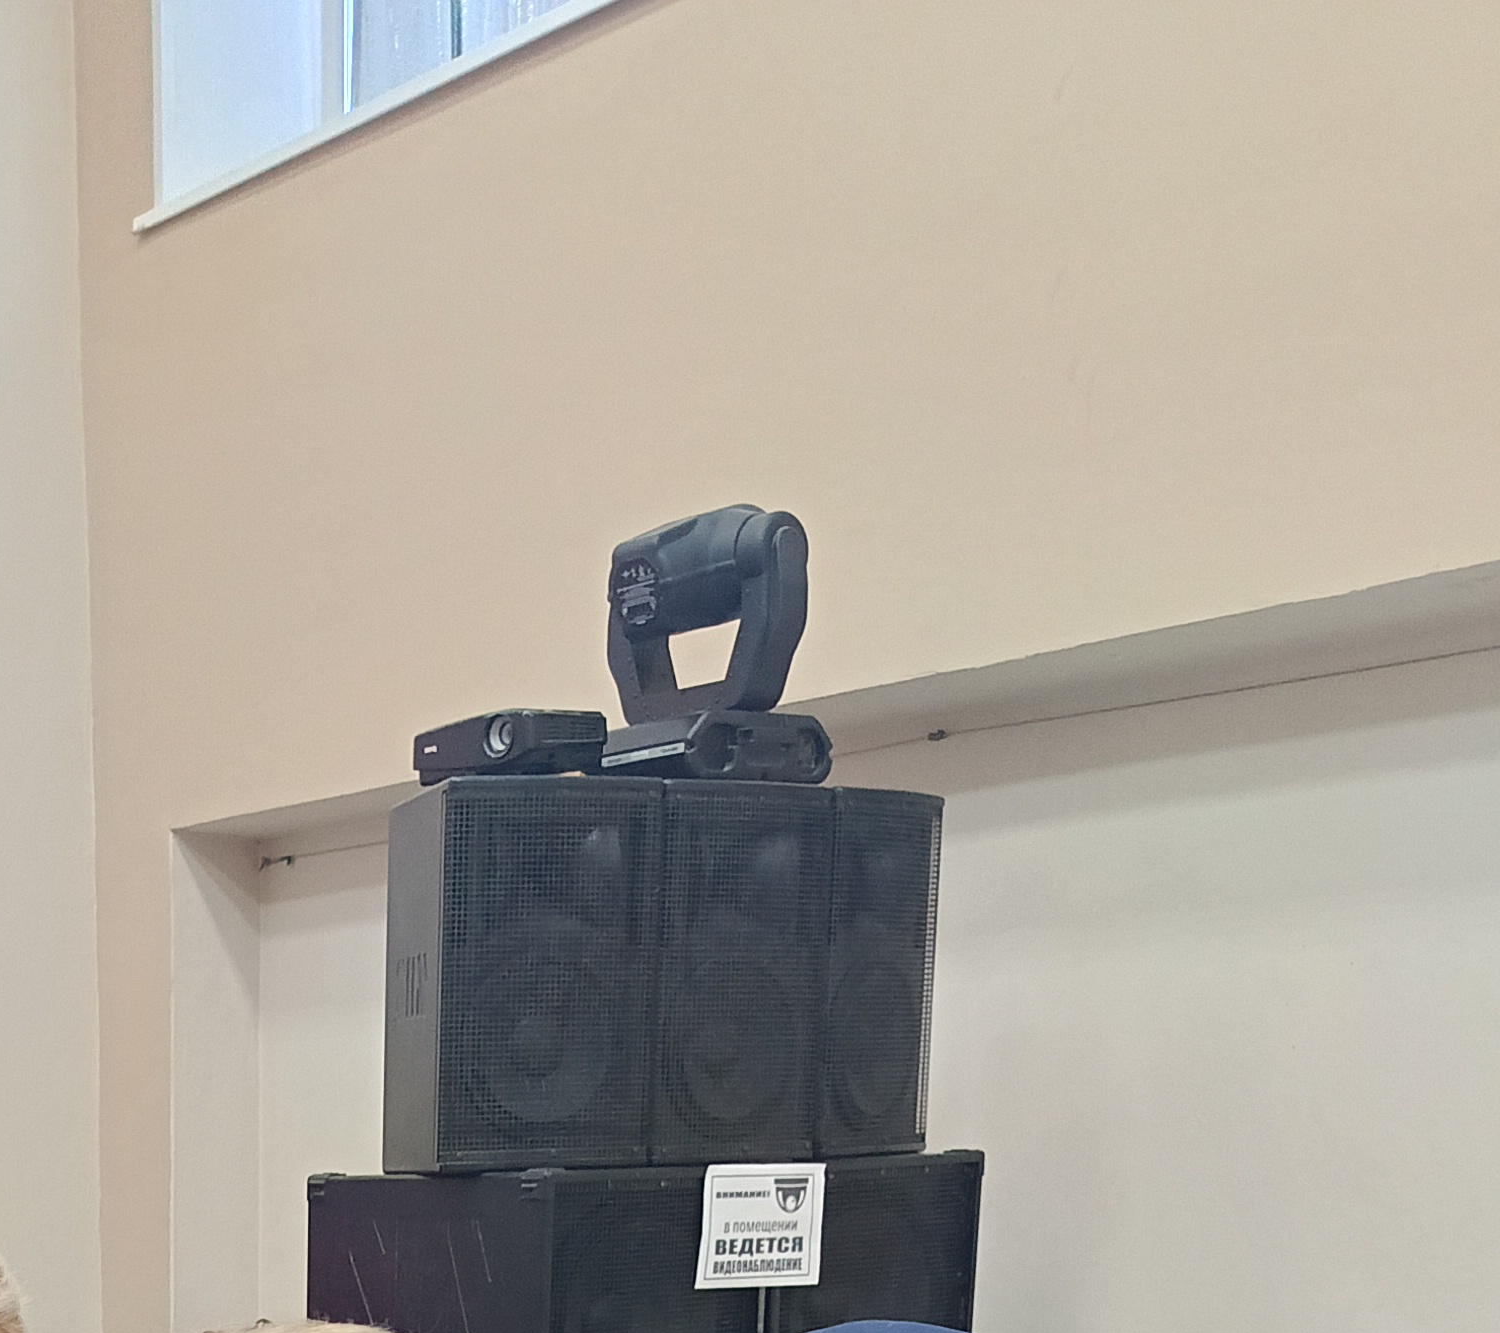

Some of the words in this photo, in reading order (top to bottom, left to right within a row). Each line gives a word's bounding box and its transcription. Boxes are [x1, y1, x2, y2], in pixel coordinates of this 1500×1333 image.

[715, 1190, 771, 1199] ВНИМАНИЕ!
[714, 1236, 804, 1257] ВЕДЕТСЯ
[712, 1258, 803, 1276] ВИДЕОНАБЛЮДЕНИЕ
